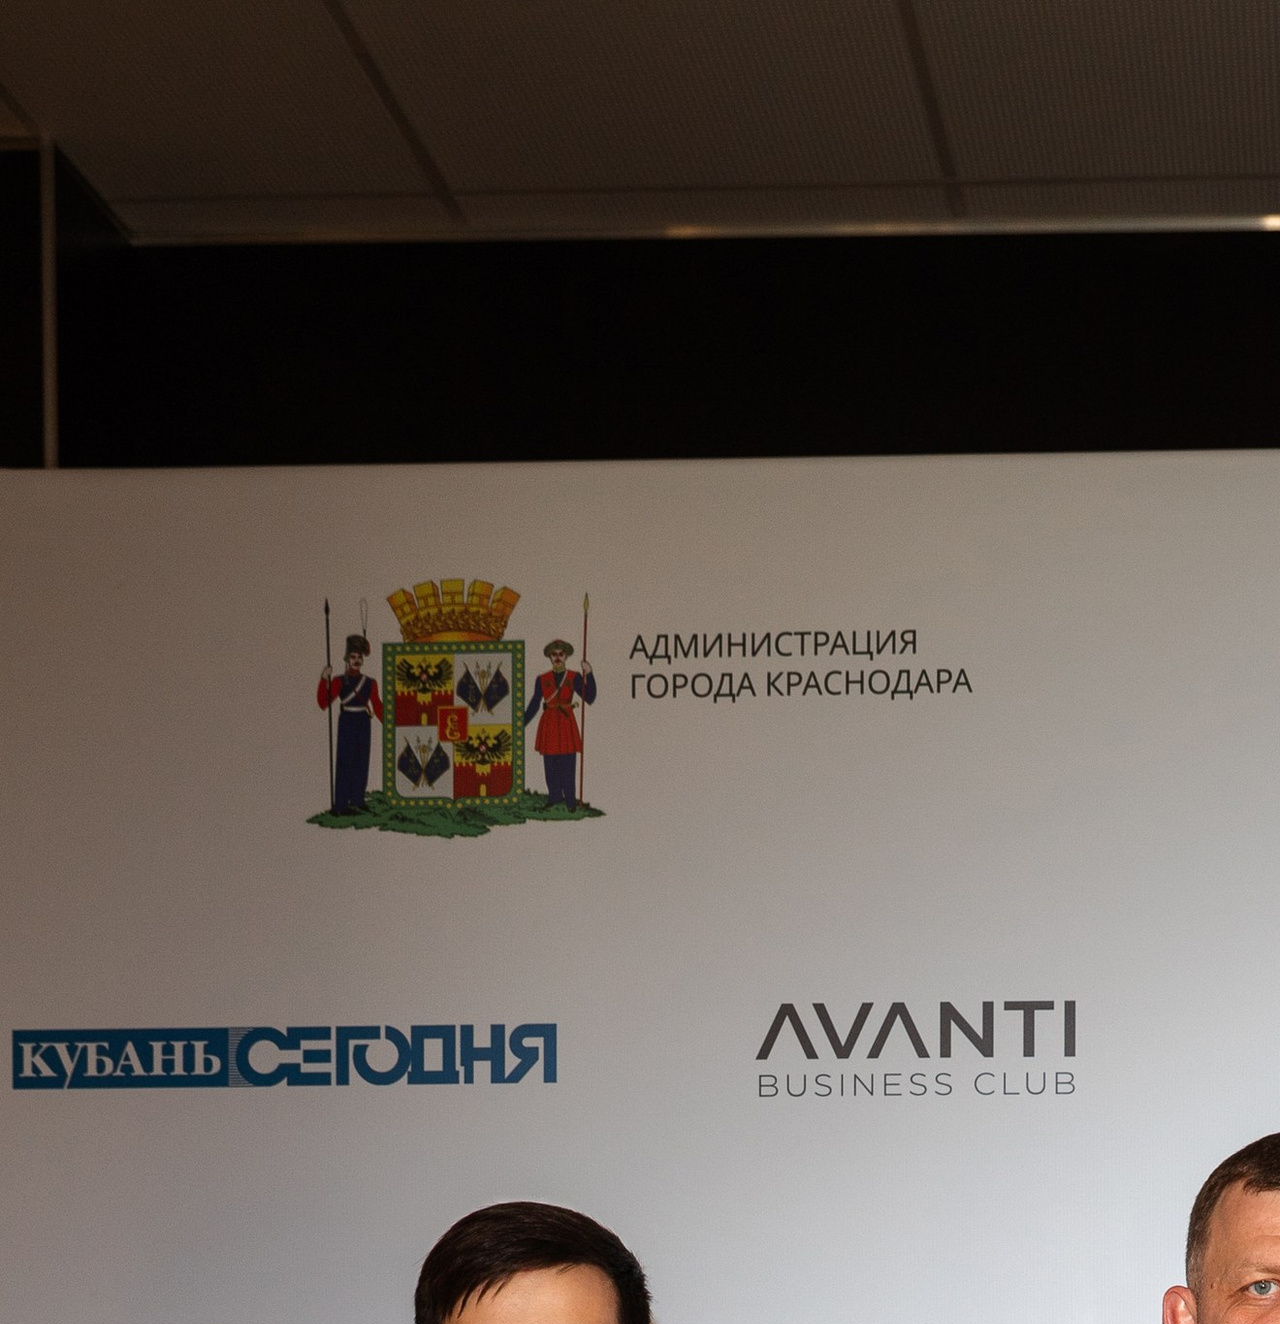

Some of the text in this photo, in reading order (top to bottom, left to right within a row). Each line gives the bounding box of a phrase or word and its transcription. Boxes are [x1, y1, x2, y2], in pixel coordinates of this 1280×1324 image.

[629, 629, 918, 665] АДМИНИСТРАЦИЯ
[631, 668, 973, 704] ГОРОДА КРАСНОДАРА
[755, 1000, 1077, 1060] AVANTI
[236, 1023, 558, 1087] СЕГОДНЯ
[758, 1071, 1076, 1098] BUSINESS CLUB
